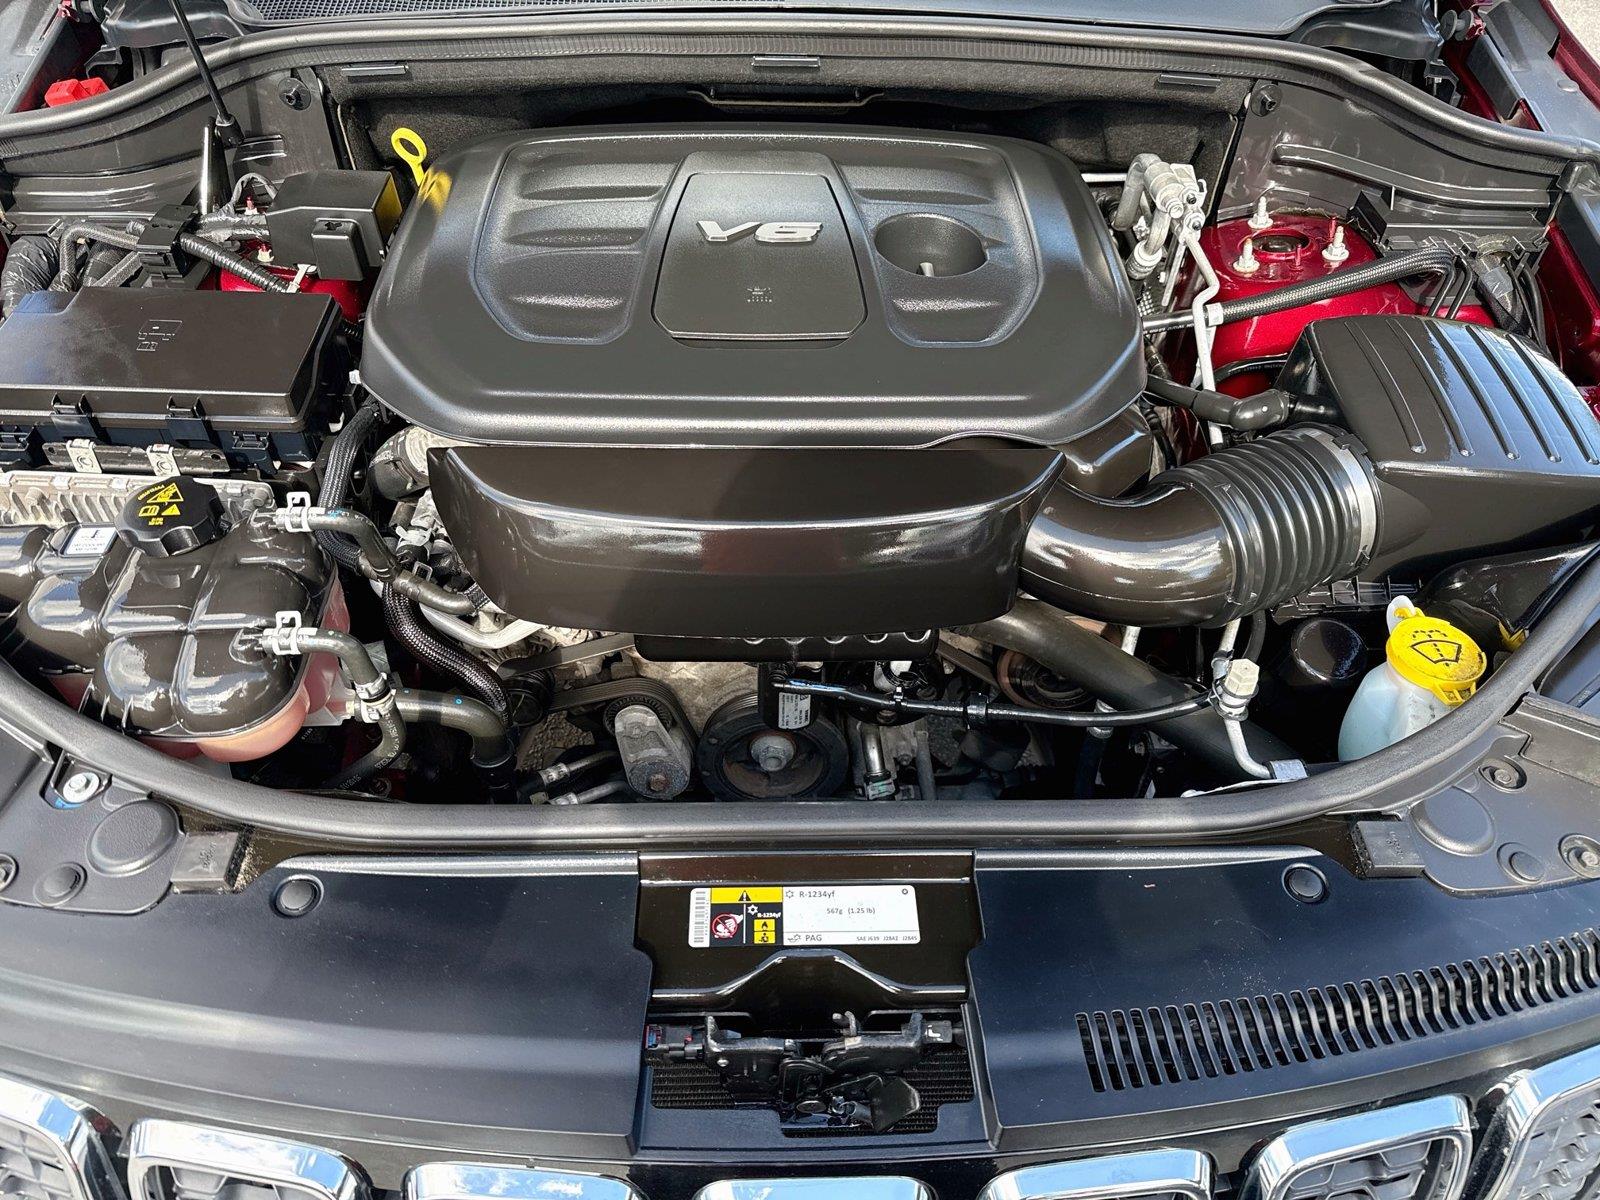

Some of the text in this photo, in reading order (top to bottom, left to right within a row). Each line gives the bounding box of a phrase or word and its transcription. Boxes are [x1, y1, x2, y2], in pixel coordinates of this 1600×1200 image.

[696, 220, 823, 244] V6
[799, 890, 835, 899] R-1234yf
[847, 907, 865, 915] (1.25
[866, 907, 876, 915] lb)
